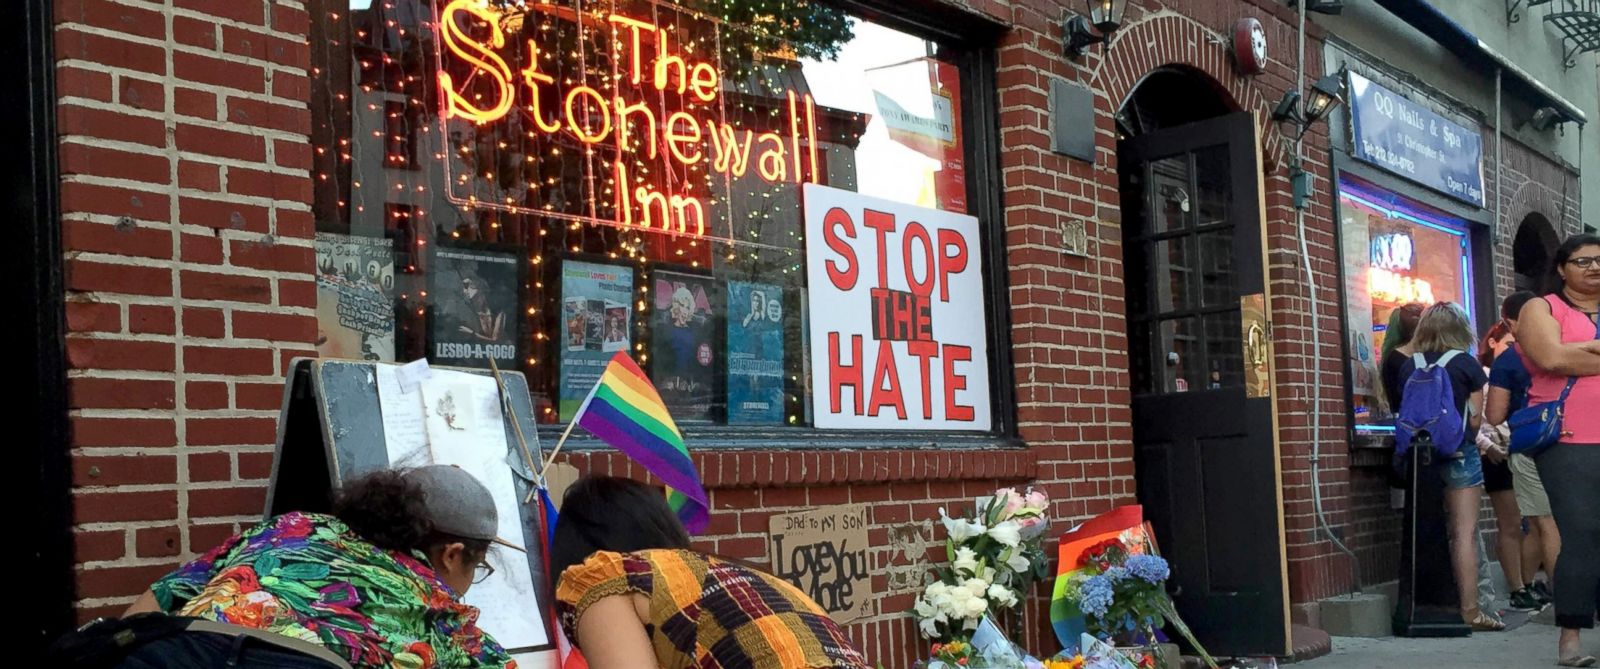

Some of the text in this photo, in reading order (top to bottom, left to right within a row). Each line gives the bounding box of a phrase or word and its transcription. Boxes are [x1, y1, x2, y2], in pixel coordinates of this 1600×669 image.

[608, 14, 717, 101] The
[437, 0, 818, 184] Stonewall
[1374, 91, 1462, 148] QQ Nails & Spa
[613, 160, 705, 238] Inn
[1447, 175, 1464, 193] Open
[823, 207, 968, 303] STOP
[870, 288, 933, 342] THE
[436, 342, 516, 360] LESBO-A-GOGO
[828, 331, 975, 422] HATE
[842, 510, 864, 530] SON
[772, 534, 869, 581] Love You
